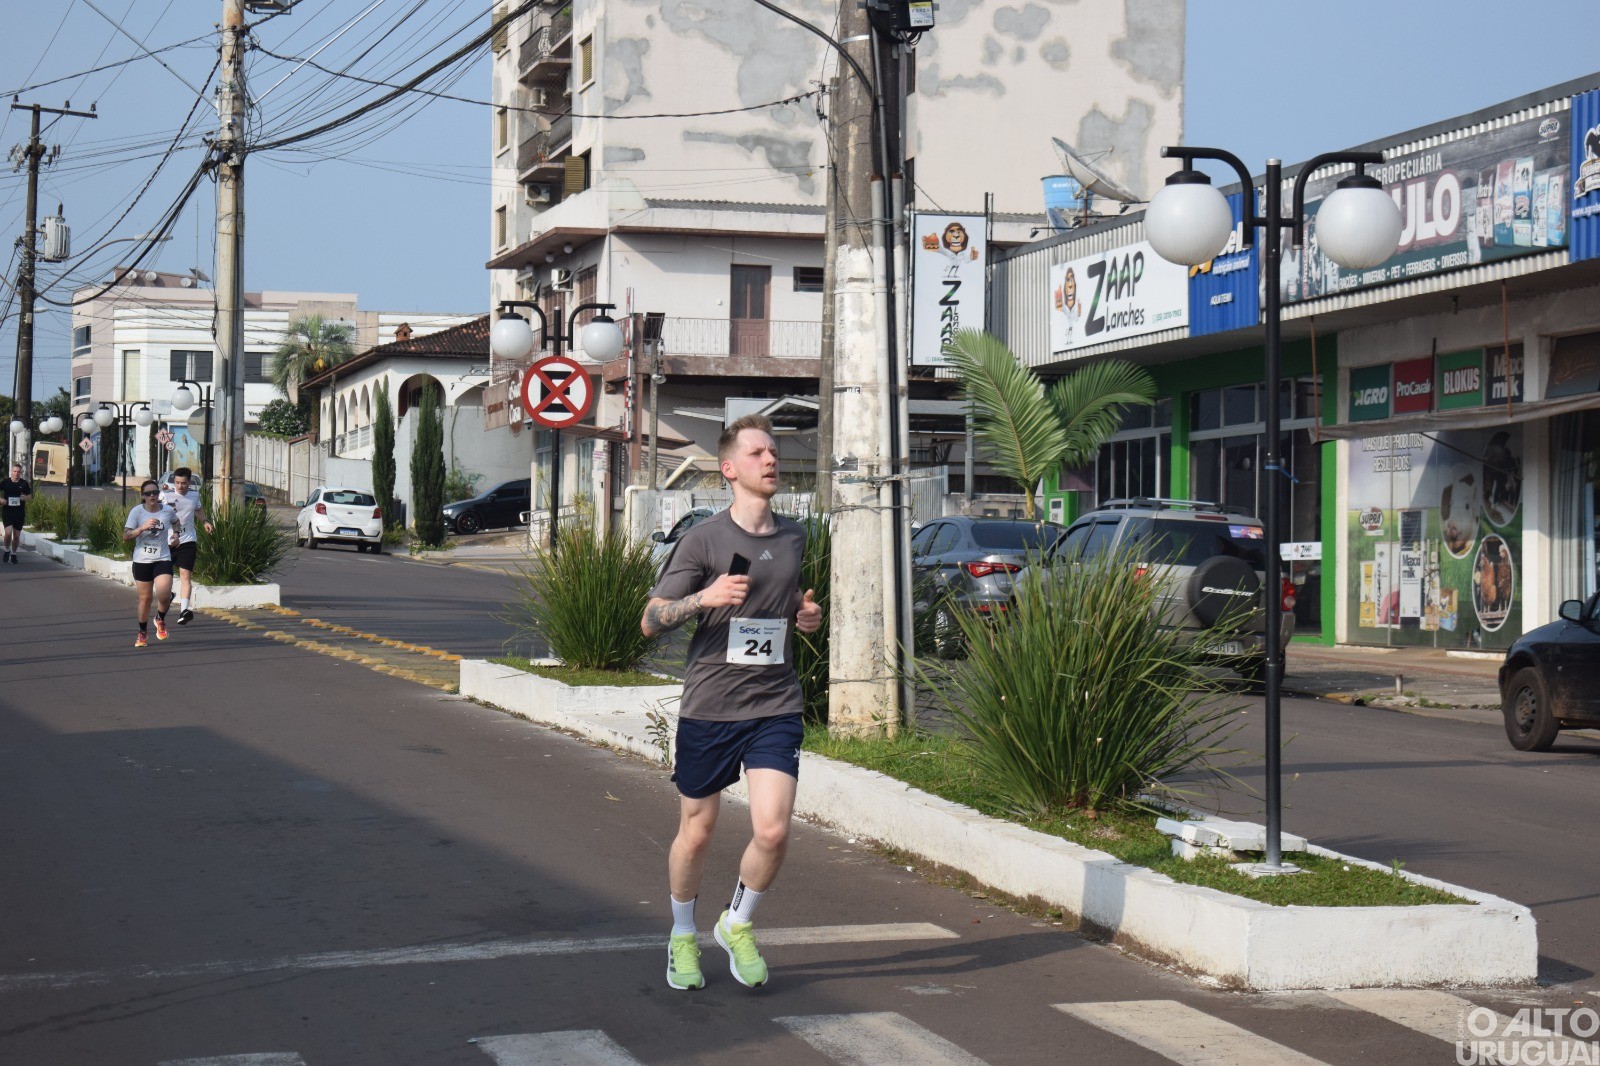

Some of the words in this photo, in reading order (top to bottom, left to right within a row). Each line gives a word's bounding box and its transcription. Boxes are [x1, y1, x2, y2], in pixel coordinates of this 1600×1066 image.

[1391, 173, 1459, 246] ULO
[1363, 268, 1386, 285] MINERAIS
[1391, 265, 1401, 279] PET
[1406, 258, 1436, 276] FERRAGENS
[1441, 251, 1468, 269] DIVERSOS
[1085, 251, 1144, 337] ZAAP
[1105, 302, 1145, 333] Lanches
[1443, 367, 1480, 395] BLOKUS
[1354, 386, 1388, 407] AGRO
[1361, 511, 1381, 525] SUPRA
[144, 546, 158, 554] 137
[1402, 567, 1416, 578] milk
[739, 626, 761, 635] Sesc
[744, 639, 772, 657] 24
